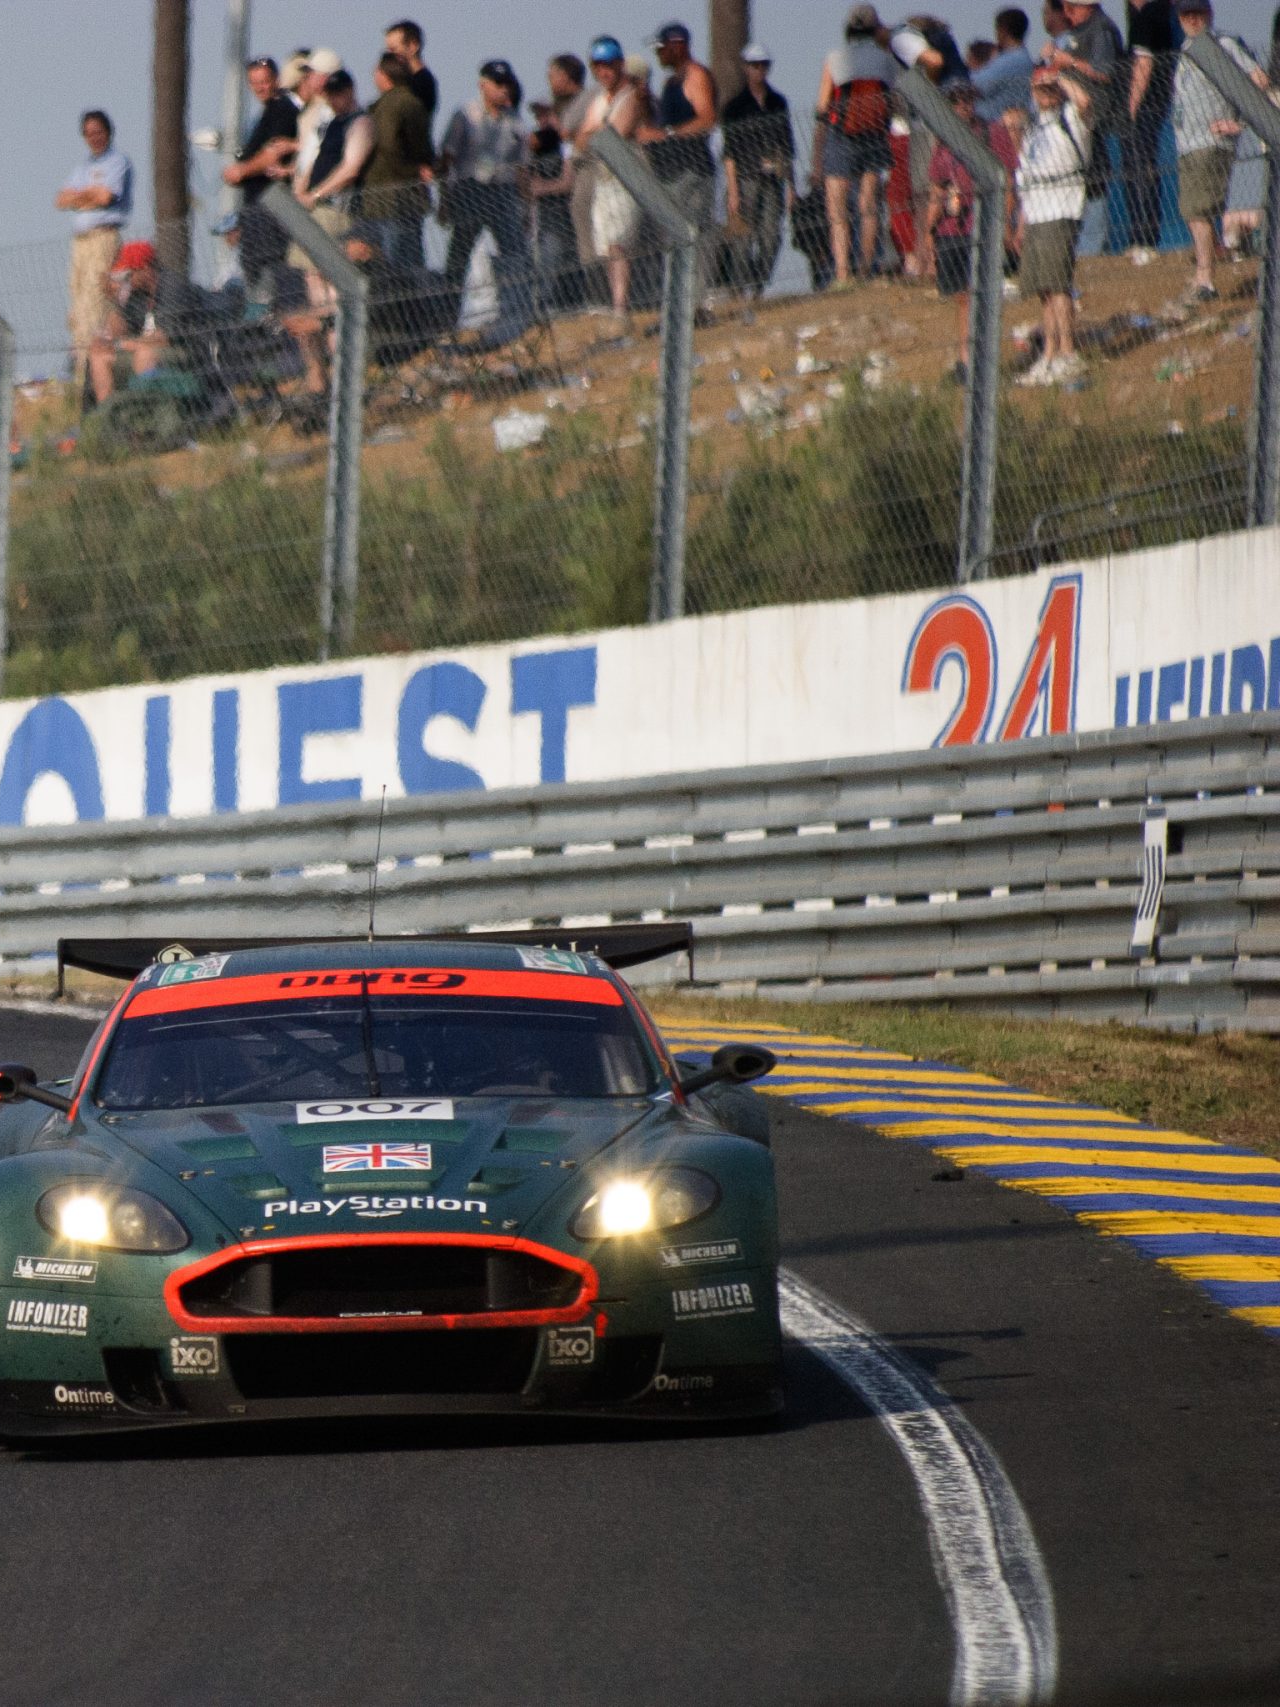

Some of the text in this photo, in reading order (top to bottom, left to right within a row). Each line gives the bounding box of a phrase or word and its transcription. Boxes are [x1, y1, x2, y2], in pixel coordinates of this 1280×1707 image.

[279, 972, 467, 989] DBR9
[305, 1101, 443, 1117] 007
[264, 1195, 488, 1218] PlayStation
[681, 1243, 737, 1260] MICHELIN
[35, 1262, 93, 1276] MICHELIN
[672, 1283, 753, 1313] INFONIZER
[7, 1299, 89, 1328] INFONIZER
[654, 1374, 714, 1391] Ontime
[54, 1385, 115, 1404] Ontime
